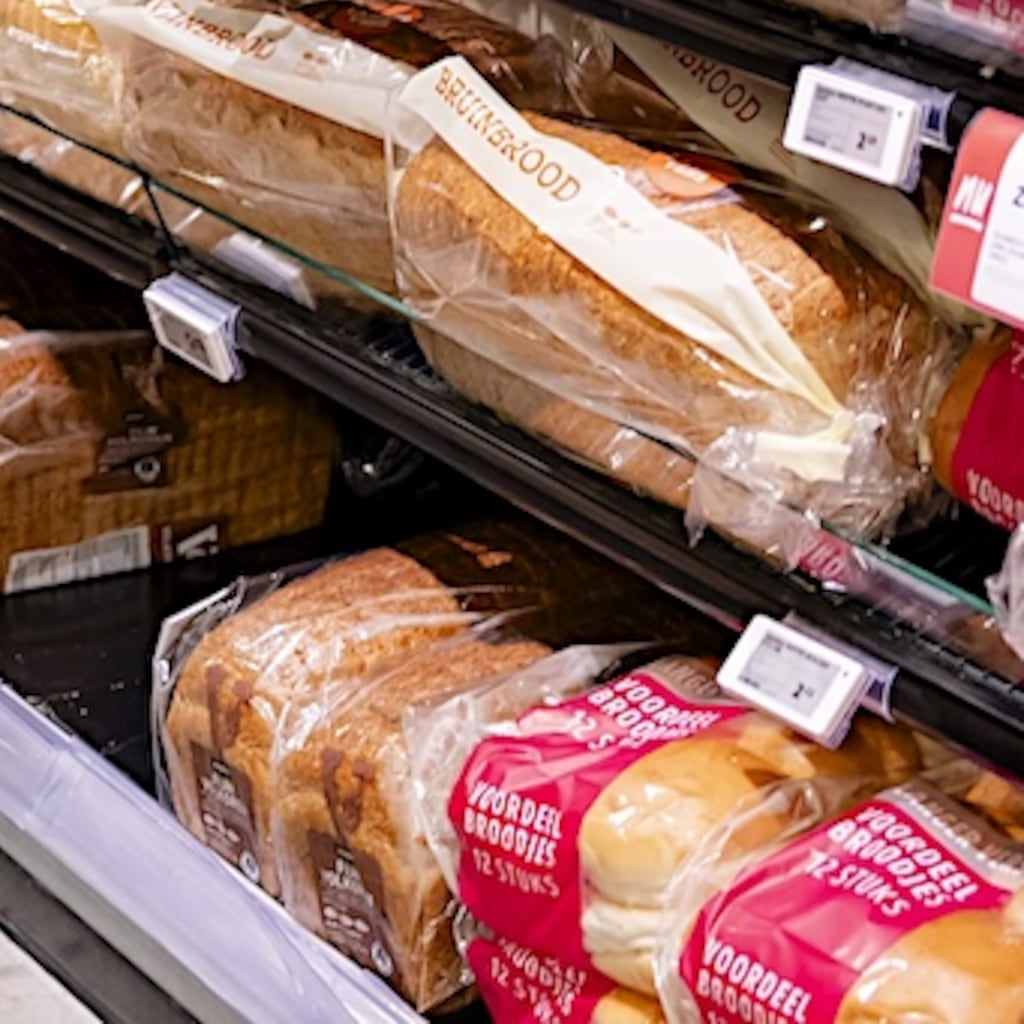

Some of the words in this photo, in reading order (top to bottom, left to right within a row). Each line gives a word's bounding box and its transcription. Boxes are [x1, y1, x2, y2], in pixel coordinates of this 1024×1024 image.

[434, 66, 581, 202] BRUINBROOD
[587, 687, 690, 747] BROO
[463, 806, 558, 869] BROODJES
[468, 780, 563, 840] VOORDEEL
[472, 847, 494, 876] 12
[494, 857, 561, 898] STUKS
[804, 848, 840, 880] 12
[827, 864, 912, 918] STUKS
[827, 818, 953, 908] BROODJES
[855, 806, 979, 904] VOORDEEL
[702, 936, 813, 1024] VOORDEEL
